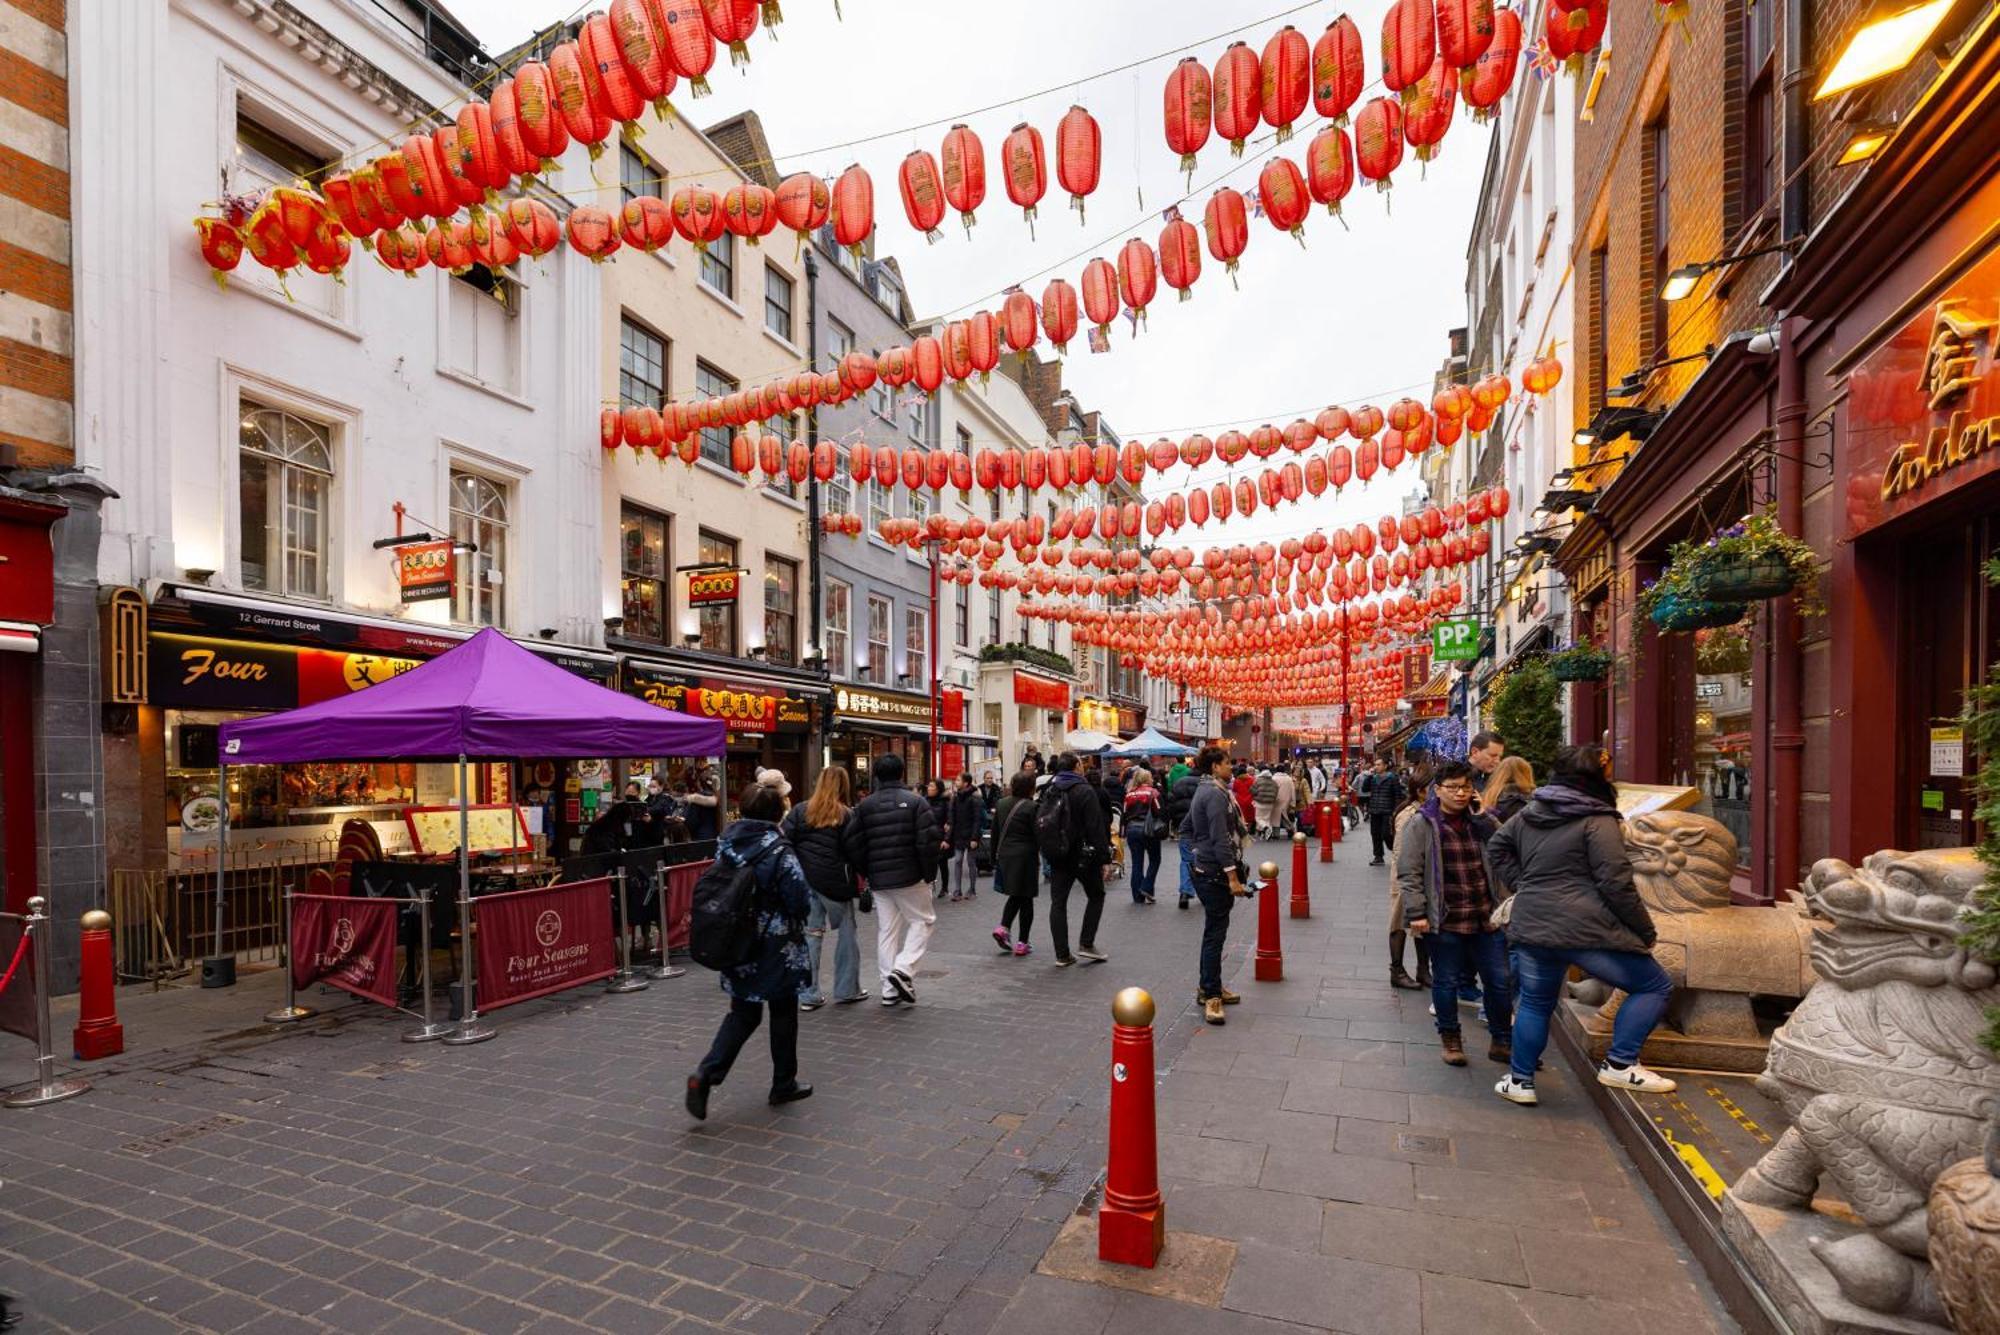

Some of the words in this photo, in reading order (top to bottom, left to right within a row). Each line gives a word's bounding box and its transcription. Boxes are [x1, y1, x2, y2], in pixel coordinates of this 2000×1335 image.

[1882, 410, 2000, 500] Golden
[240, 613, 251, 622] 12
[254, 614, 290, 628] Gerrard
[292, 619, 321, 631] Street
[181, 649, 268, 685] Four
[645, 689, 678, 710] Four
[730, 720, 766, 729] RESTAURANT
[507, 955, 540, 973] Four
[543, 943, 590, 964] Seasons
